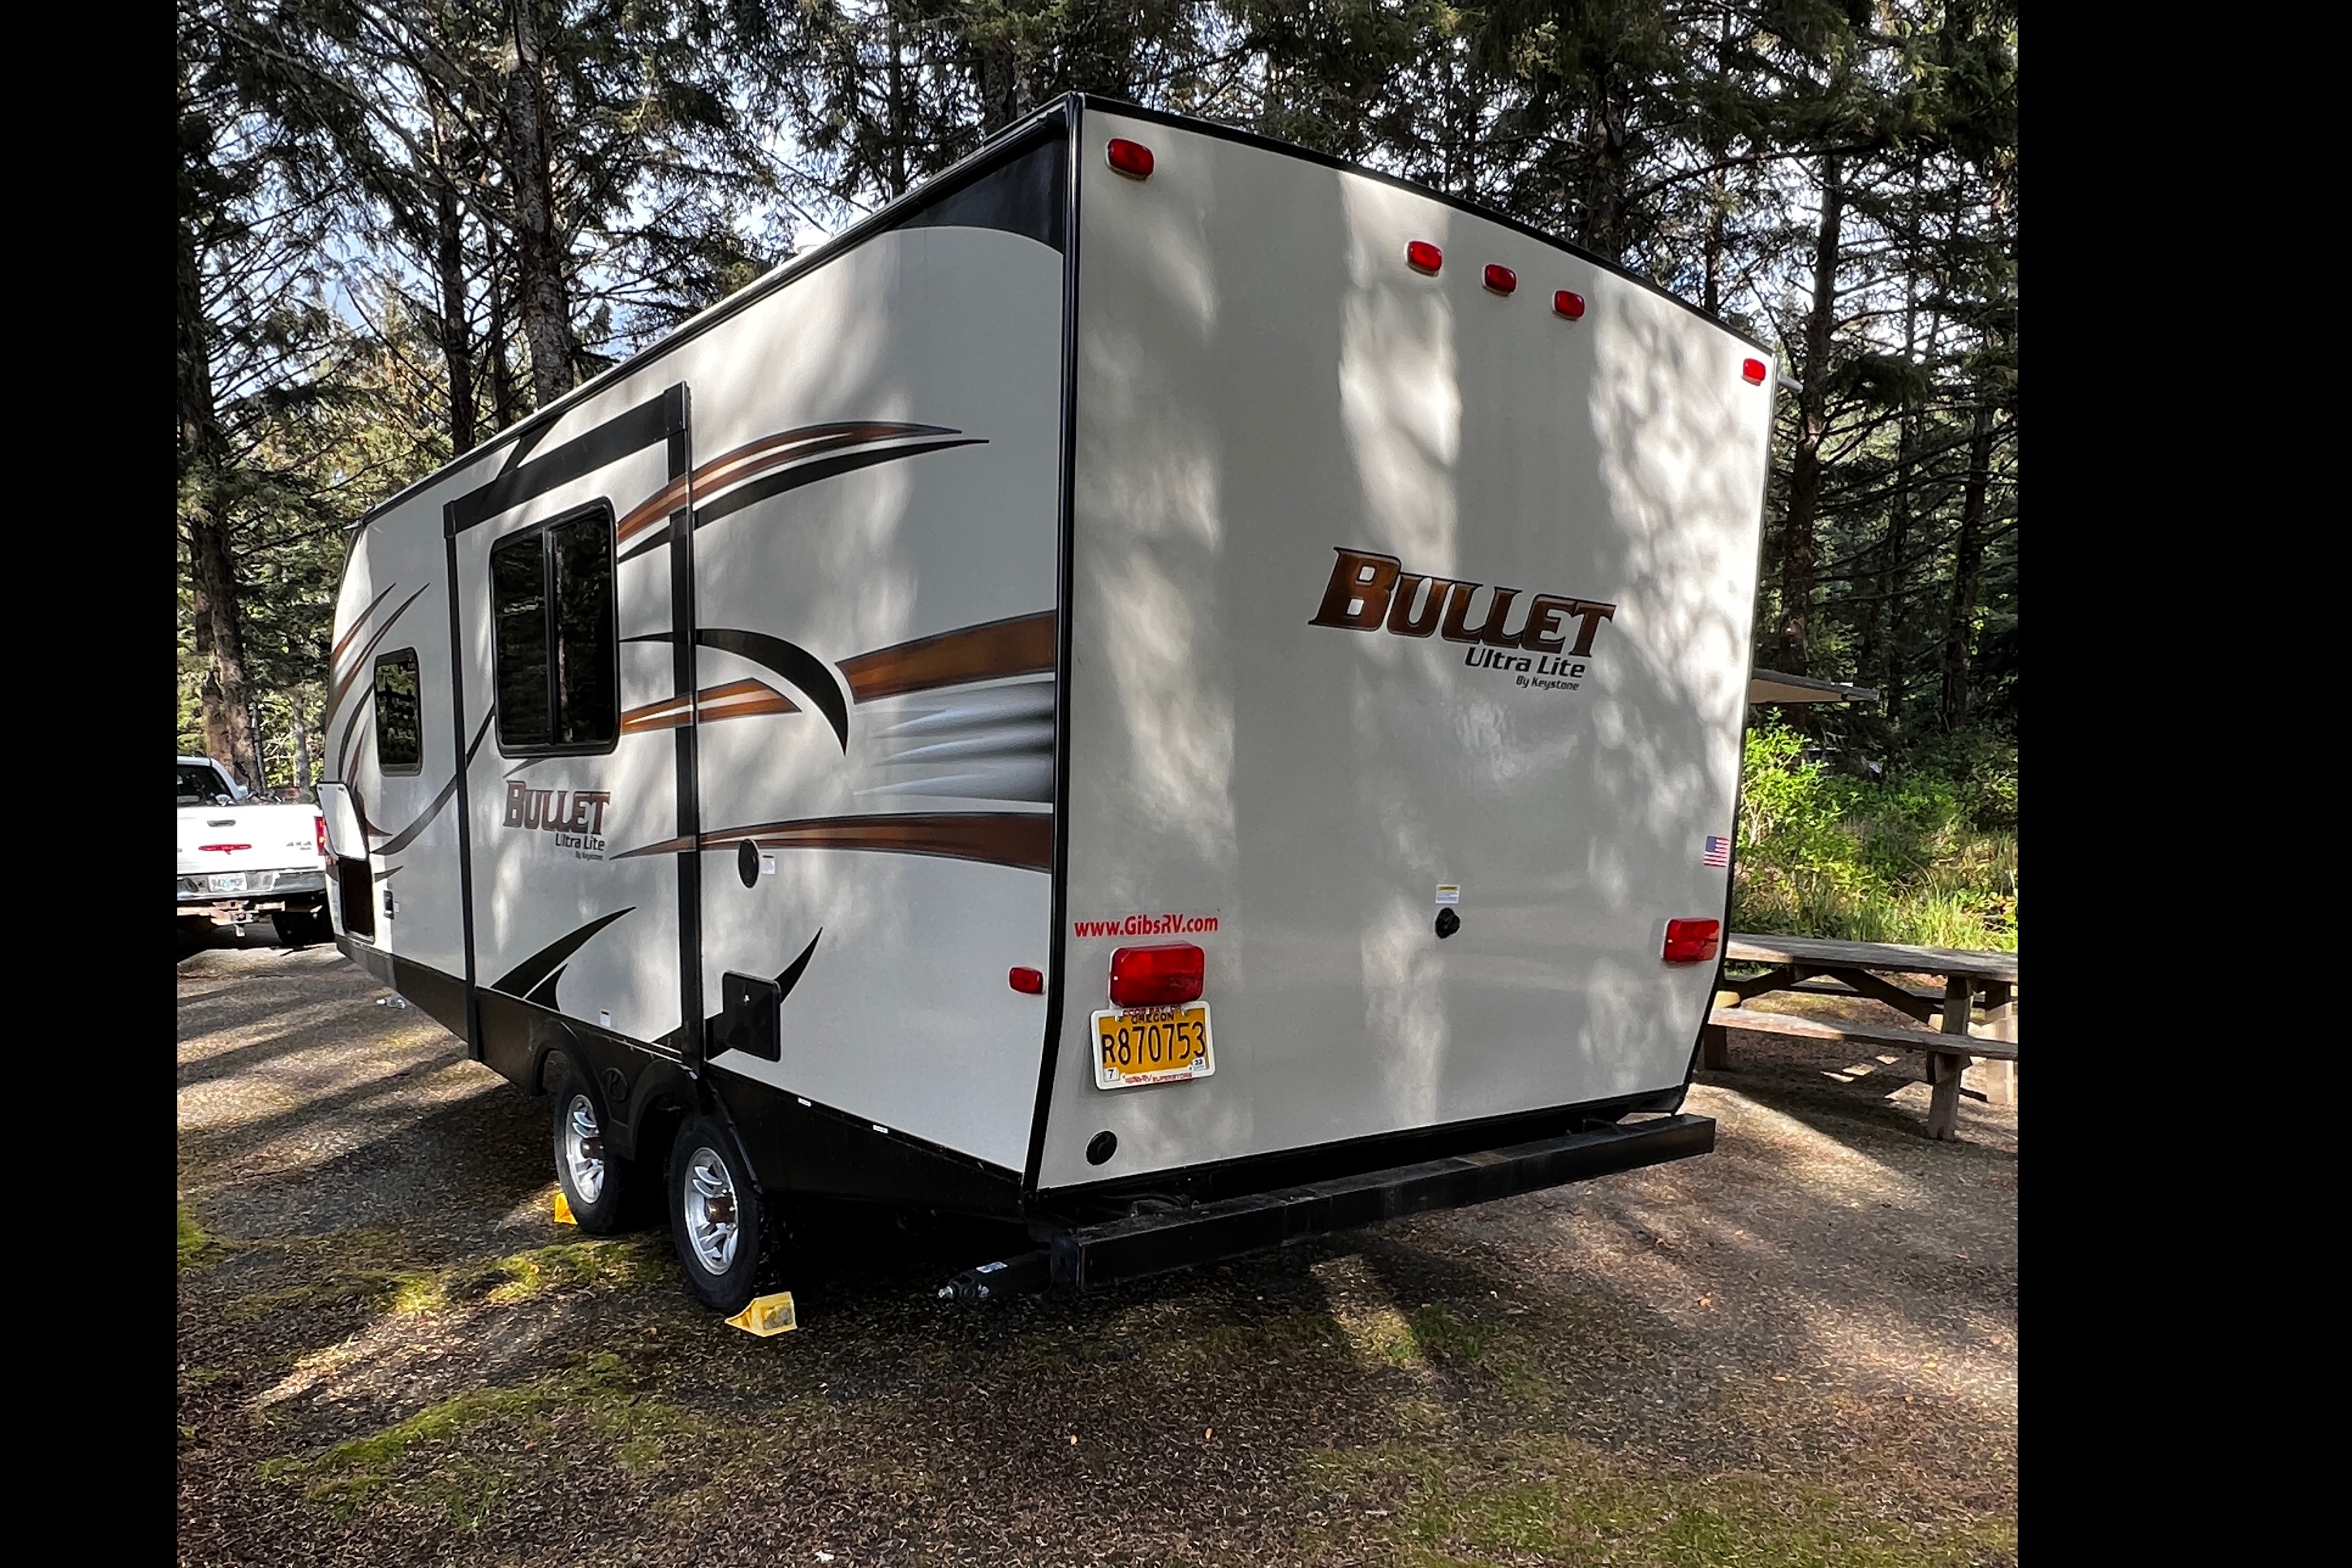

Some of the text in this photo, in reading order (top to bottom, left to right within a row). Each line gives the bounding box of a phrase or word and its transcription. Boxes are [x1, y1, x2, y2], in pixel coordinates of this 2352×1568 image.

[1307, 546, 1617, 658] BULLET
[1465, 646, 1586, 679] Ultra Lite
[1516, 675, 1580, 690] By Keystone
[503, 780, 611, 835] BULLET
[555, 833, 605, 852] Ultra Lite
[1074, 914, 1218, 937] www.GibsRV.com
[1130, 1012, 1175, 1024] OREGON
[1101, 1021, 1206, 1066] R870753
